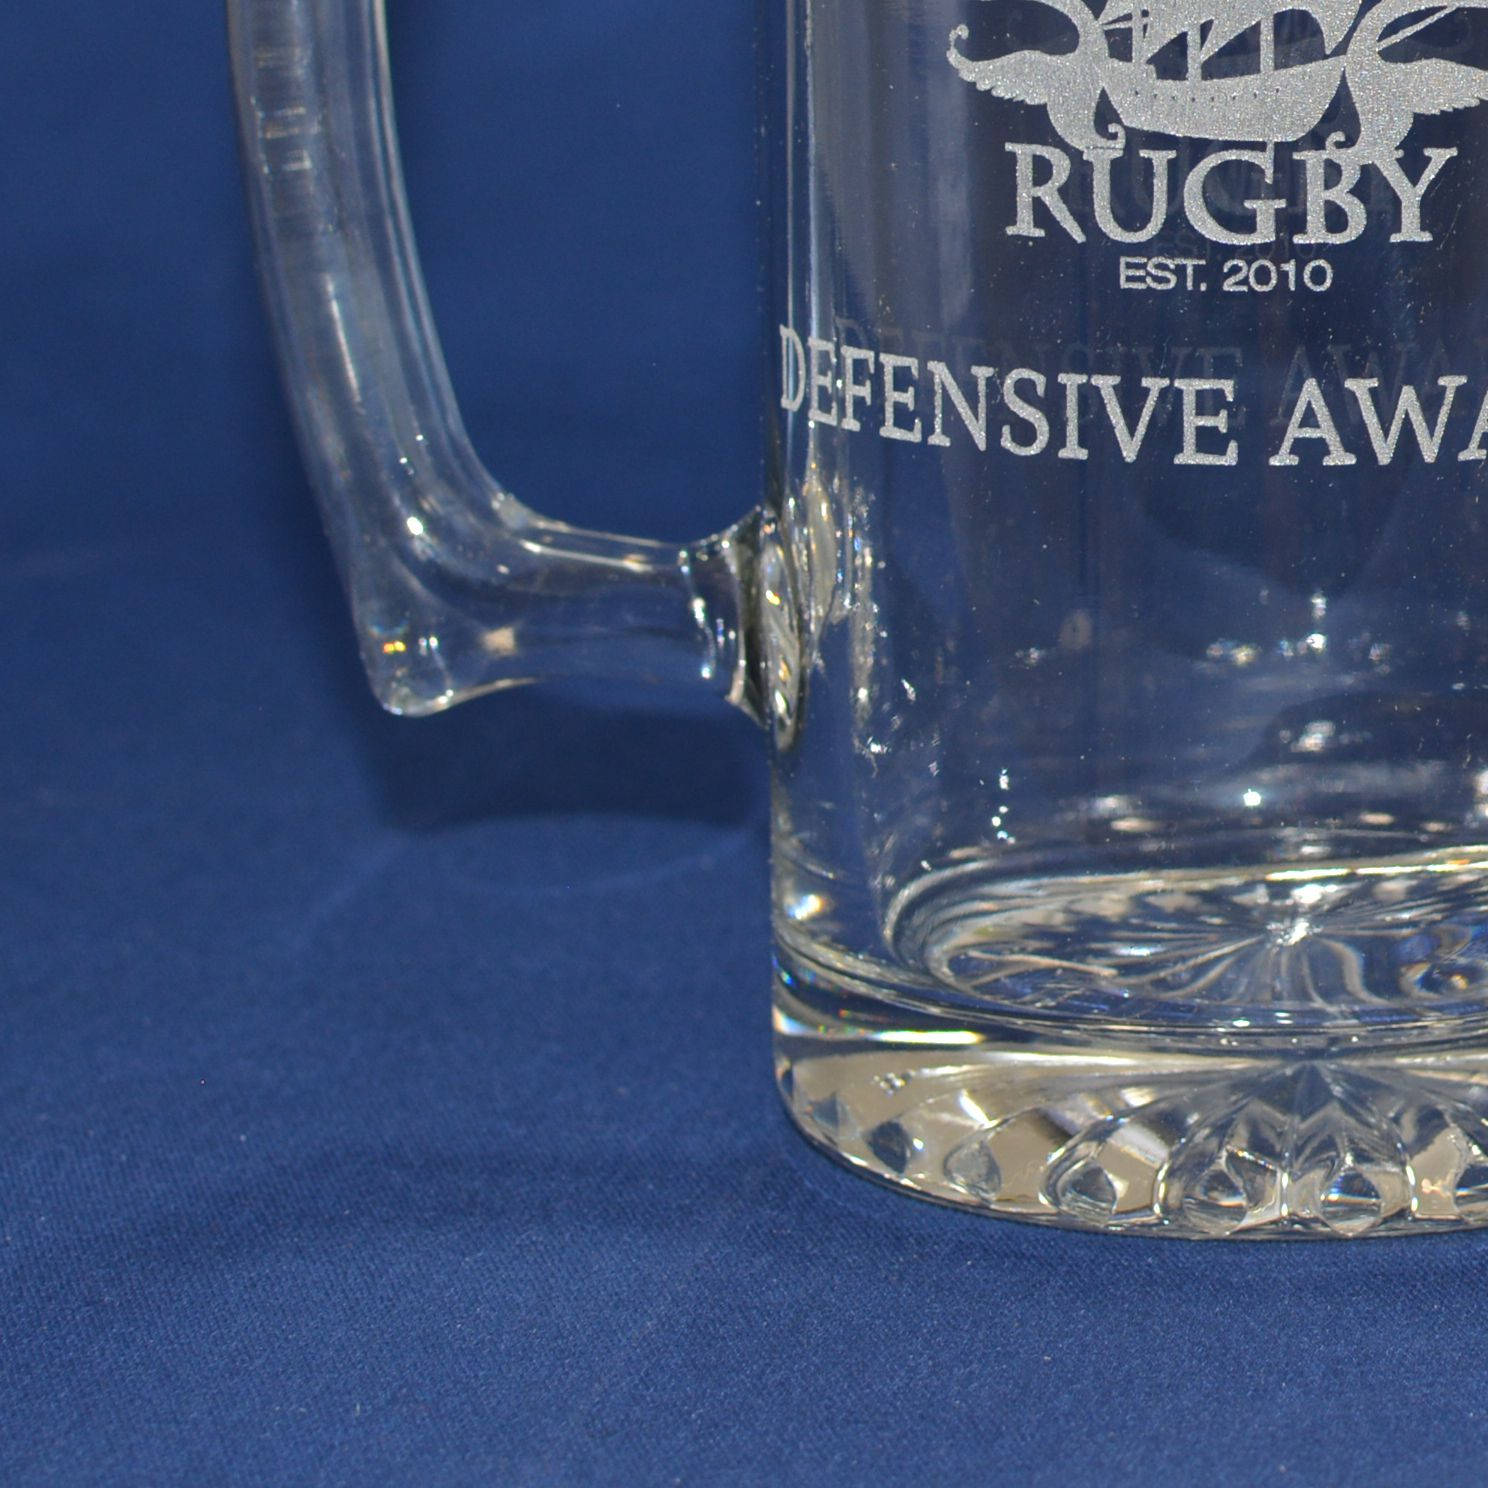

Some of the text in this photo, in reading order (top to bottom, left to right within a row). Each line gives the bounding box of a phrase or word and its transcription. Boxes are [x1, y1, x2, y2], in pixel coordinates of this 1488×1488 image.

[1004, 141, 1459, 246] RUGBY
[1118, 255, 1335, 293] EST. 2010
[779, 323, 1239, 467] DEFENSIVE
